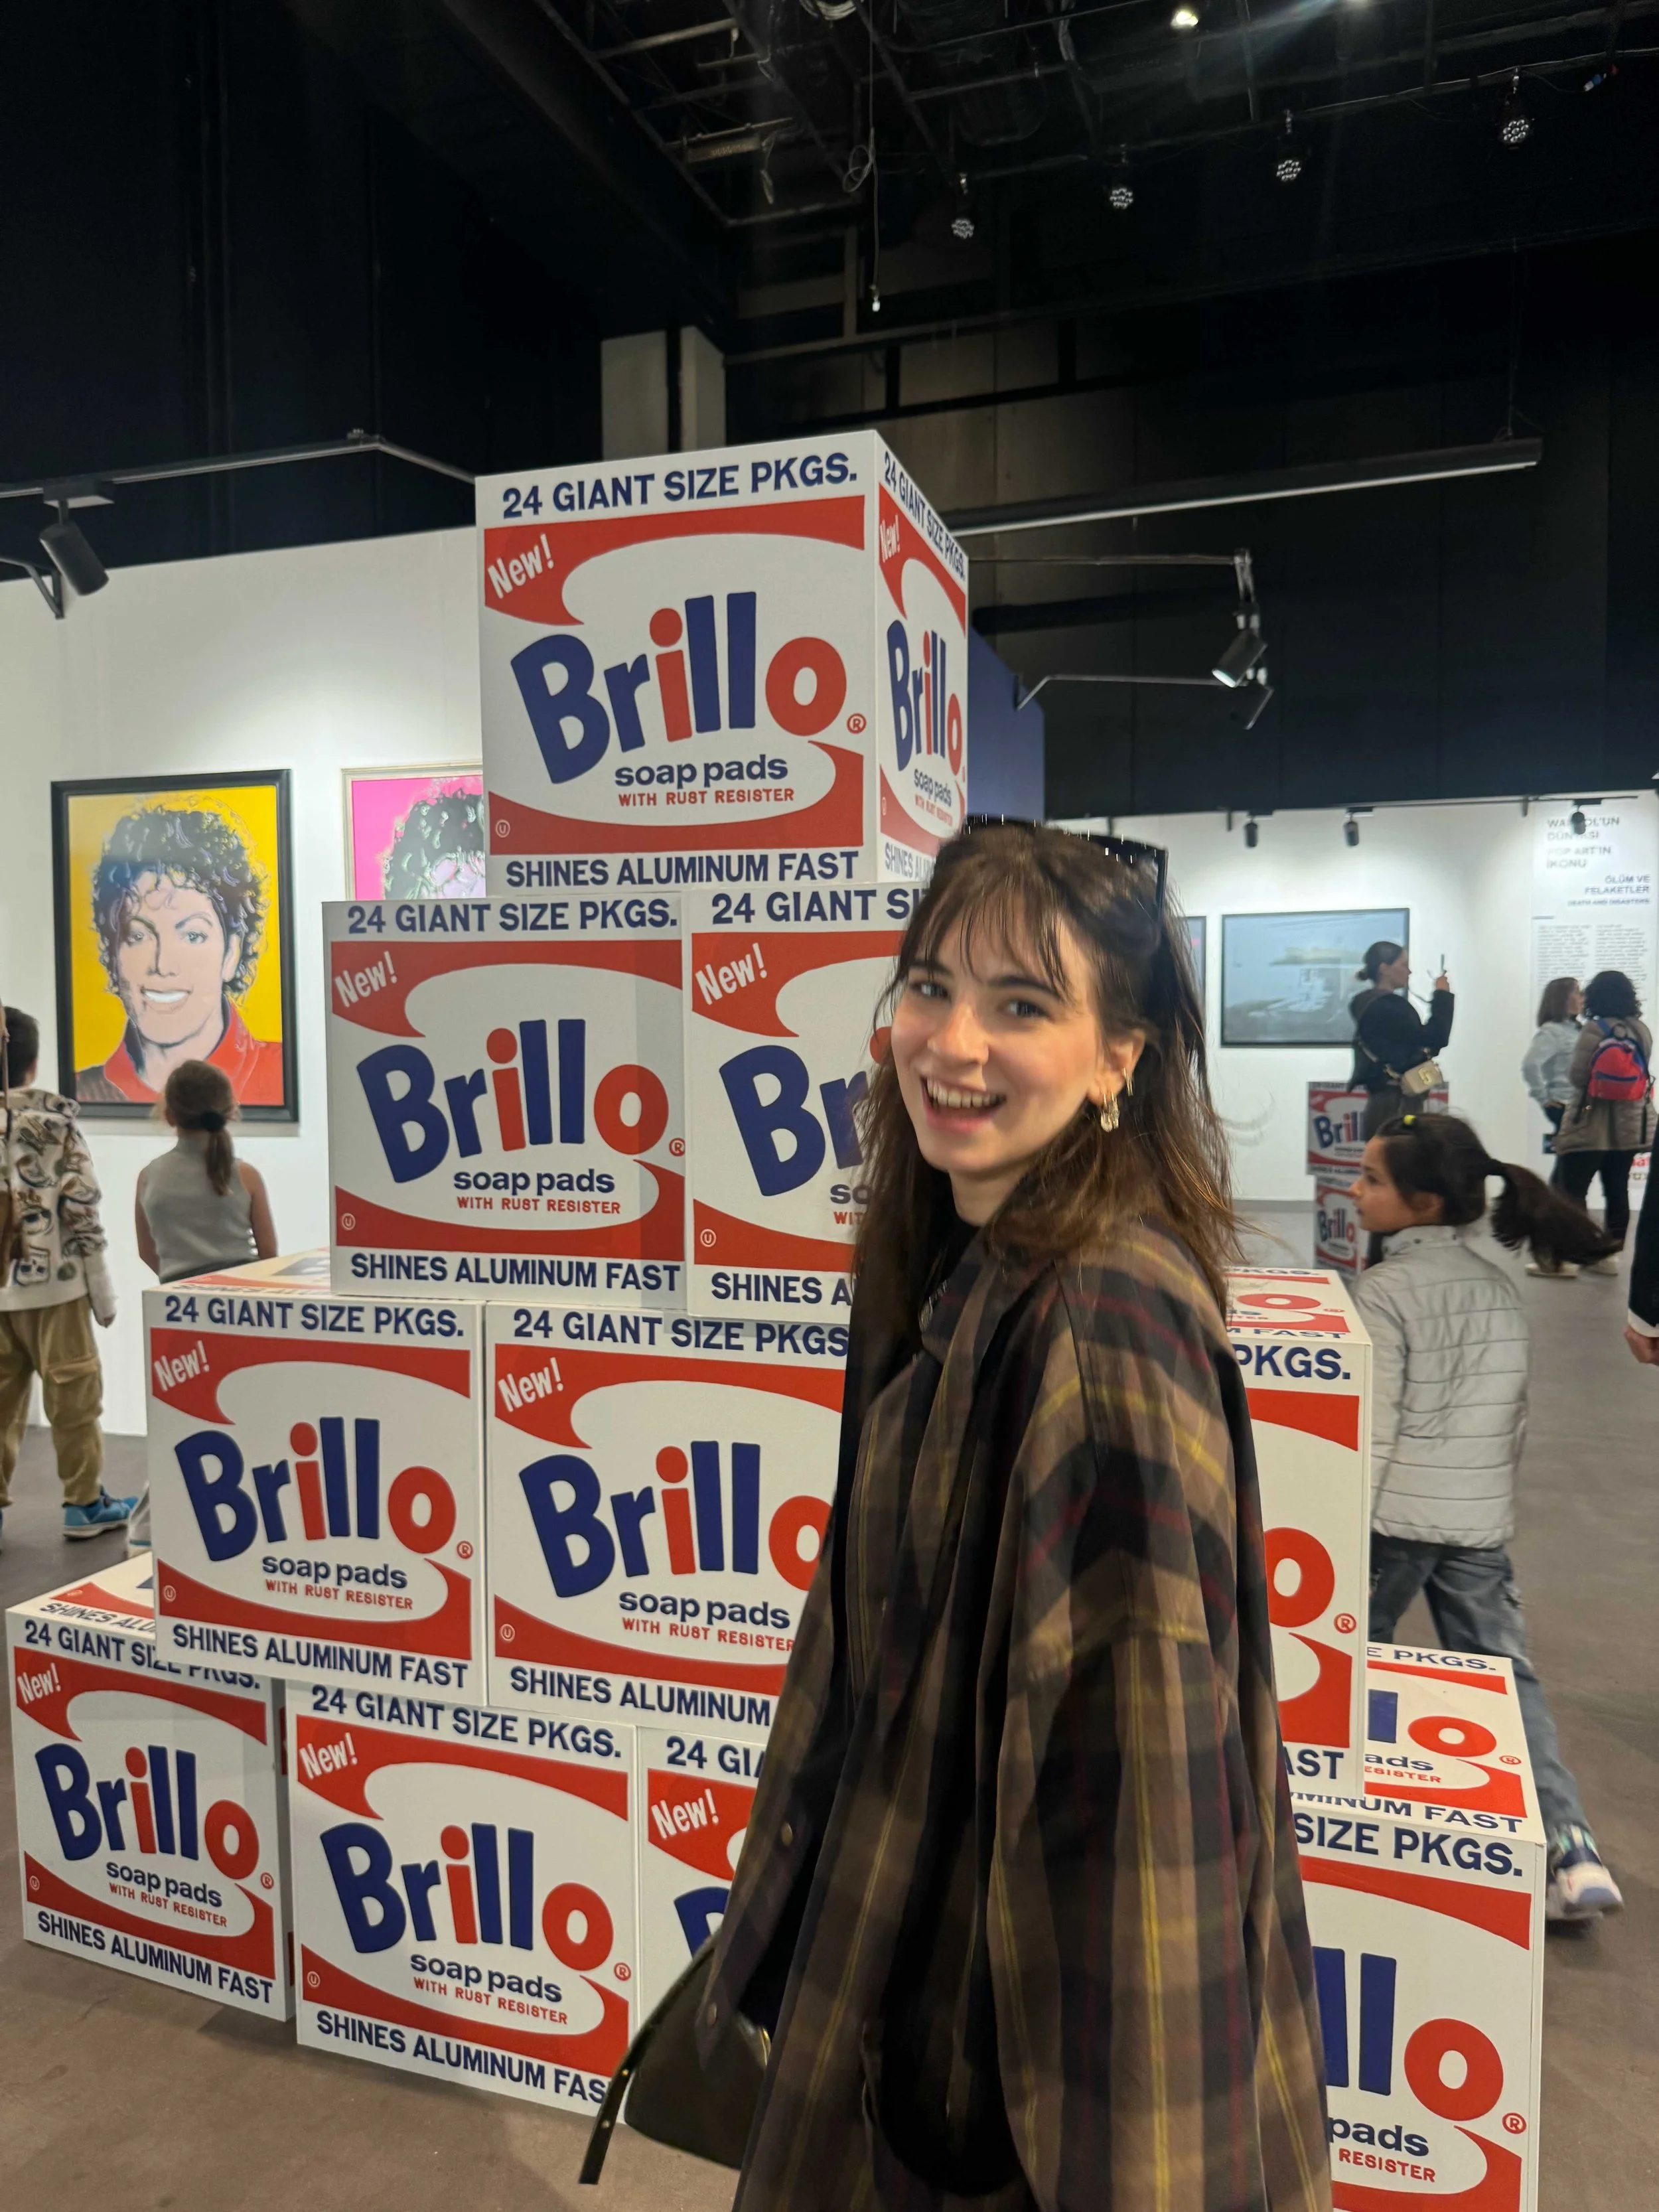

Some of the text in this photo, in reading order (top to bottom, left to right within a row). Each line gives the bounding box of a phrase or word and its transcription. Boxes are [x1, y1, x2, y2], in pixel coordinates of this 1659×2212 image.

[502, 452, 857, 519] 24 GIANT SIZE PKGS.
[885, 451, 965, 581] 24 GIANT SIZE PKGS.
[880, 514, 900, 563] New!
[487, 534, 554, 599] New!
[510, 591, 847, 784] Brillo
[887, 620, 962, 776] Brillo
[614, 754, 788, 790] soap pads
[914, 768, 951, 807] soap pads
[618, 787, 794, 806] WITH RUST RESISTER
[506, 850, 859, 887] SHINES ALUMINUM FAST
[885, 842, 913, 878] SHINES
[1637, 874, 1650, 883] VE
[348, 898, 678, 934] 24 GIANT SIZE PKGS.
[711, 889, 919, 925] 24 GIANT SI
[334, 950, 397, 1007] New!
[695, 942, 767, 1005] New!
[356, 1019, 669, 1184] Brillo
[1313, 1111, 1367, 1149] Brill
[453, 1168, 615, 1197] soap pads
[830, 1184, 873, 1205] so
[457, 1197, 621, 1215] WITH RUST RESISTER
[833, 1211, 863, 1224] WIT
[351, 1253, 681, 1291] SHINES ALUMINUM FAST
[711, 1272, 822, 1304] SHINES
[165, 1294, 464, 1337] 24 GIANT SIZE PKGS.
[513, 1308, 553, 1339] 24
[563, 1311, 663, 1346] GIANT
[671, 1318, 745, 1351] SIZE
[1254, 1329, 1346, 1338] FAST
[153, 1340, 210, 1391] New!
[498, 1357, 563, 1412] New!
[175, 1416, 456, 1562] Brillo
[518, 1440, 832, 1598] Brillo
[262, 1556, 407, 1589] soap pads
[40, 1602, 116, 1622] SHINES
[265, 1580, 413, 1609] WITH RUST RESISTER
[619, 1591, 790, 1629] soap pads
[24, 1619, 52, 1647] 24
[57, 1625, 126, 1662] GIANT
[622, 1619, 661, 1635] WITH
[668, 1623, 711, 1641] RUST
[173, 1623, 258, 1658] SHINES
[265, 1637, 392, 1678] ALUMINUM
[400, 1655, 468, 1688] FAST
[1394, 1650, 1496, 1670] PKGS.
[17, 1662, 61, 1704] New!
[510, 1666, 770, 1727] SHINES ALUMINUM
[311, 1684, 621, 1758] 24 GIANT SIZE PKGS.
[299, 1732, 358, 1779] New!
[666, 1735, 707, 1769] 24
[1365, 1753, 1433, 1771] ads
[1364, 1766, 1442, 1783] ESISTER
[35, 1743, 259, 1880] Brillo
[651, 1788, 719, 1839] New!
[1425, 1805, 1523, 1833] FAST
[1295, 1812, 1523, 1877] SIZE PKGS.
[106, 1862, 222, 1912] soap pads
[109, 1883, 227, 1926] WITH RUST RESISTER
[320, 1822, 614, 1972] Brillo
[38, 1910, 273, 2004] SHINES ALUMINUM FAST
[410, 1954, 562, 2003] soap pads
[413, 1978, 567, 2024] WITH RUST RESISTER
[1313, 1946, 1504, 2121] llo
[317, 2010, 607, 2104] SHINES ALUMINUM FAS
[1328, 2117, 1429, 2156] pads
[1338, 2148, 1435, 2183] RESISTER
